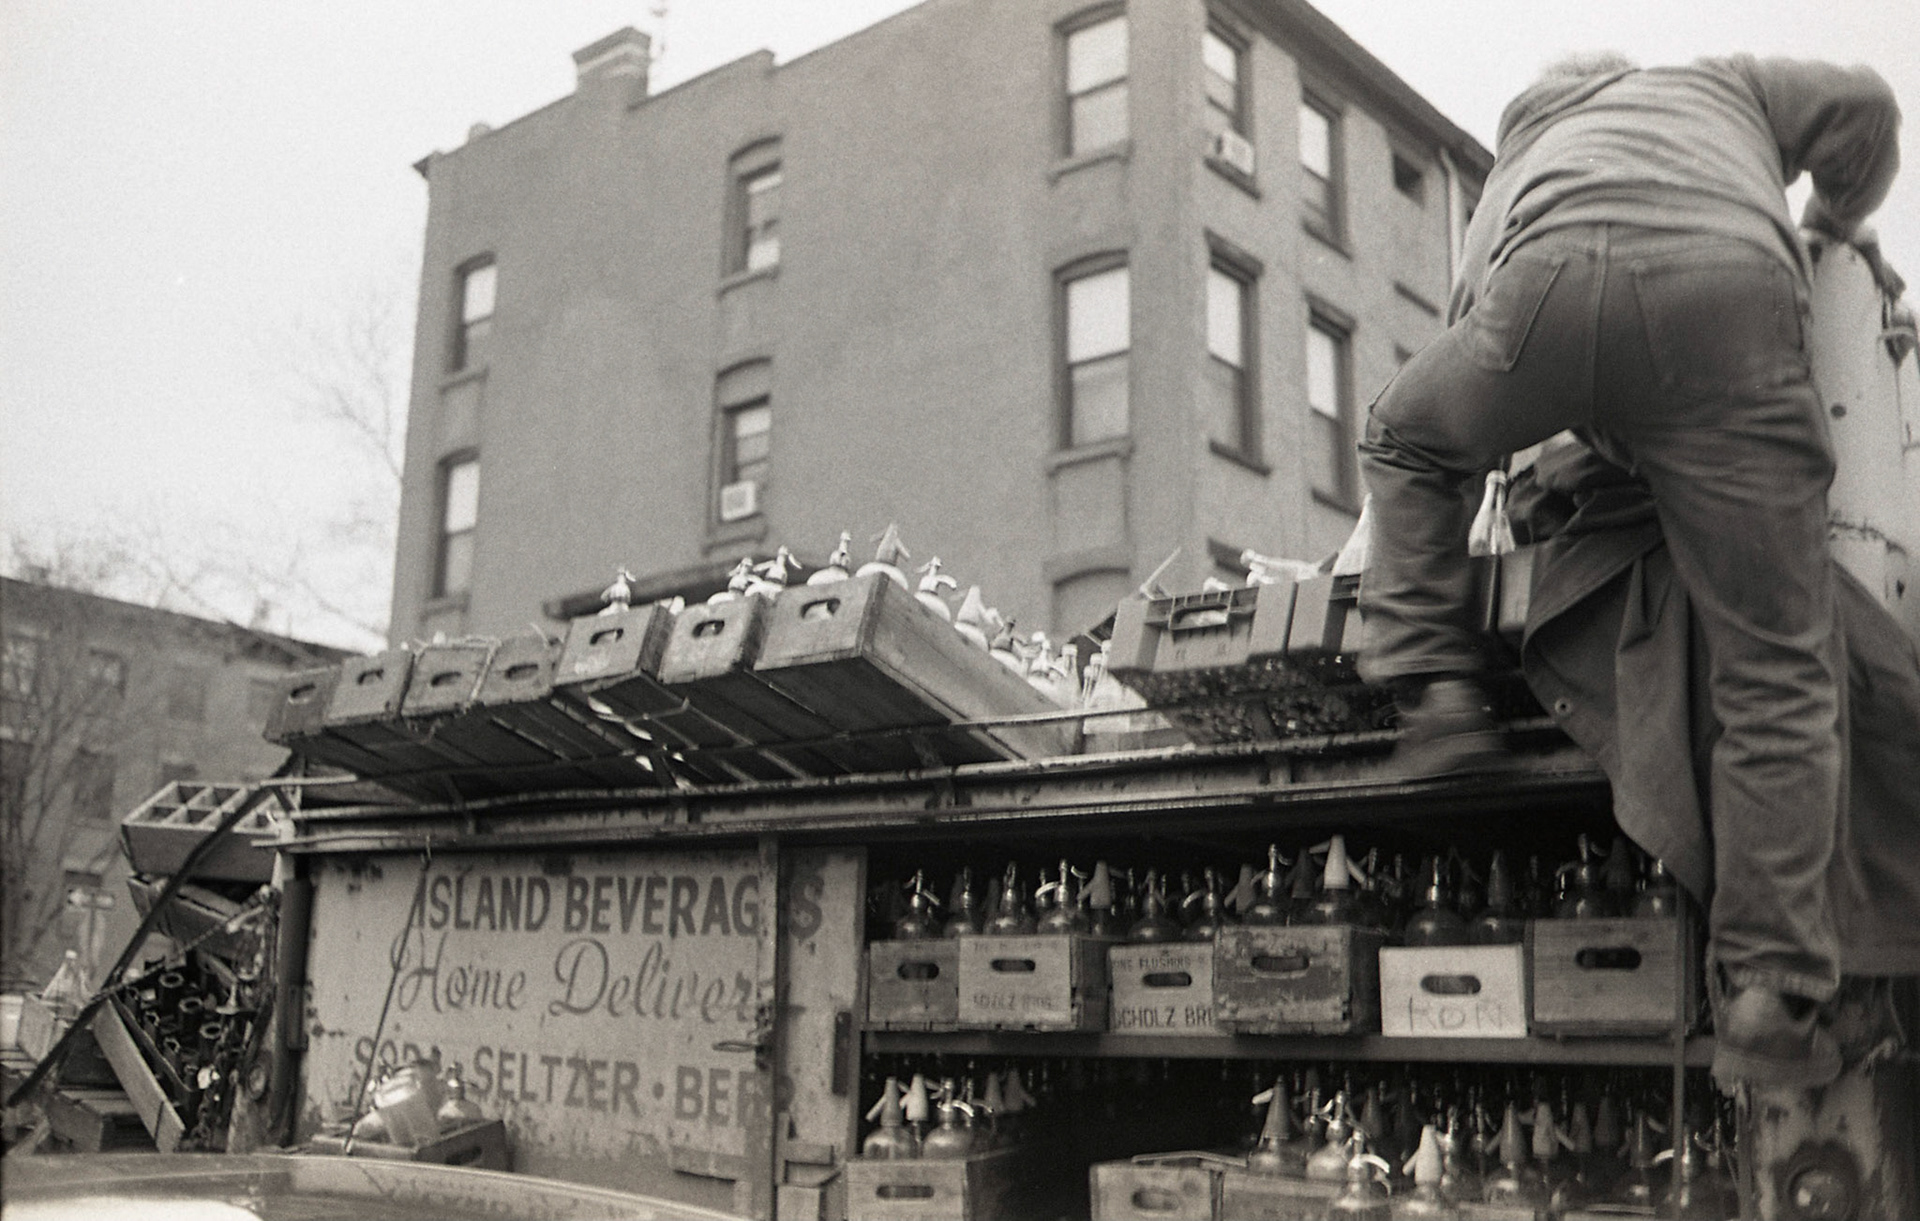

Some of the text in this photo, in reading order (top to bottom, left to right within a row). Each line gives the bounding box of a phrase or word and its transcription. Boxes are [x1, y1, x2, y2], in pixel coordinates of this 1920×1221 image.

[412, 874, 825, 940] ISLAND BEVERAGS
[390, 932, 775, 1022] Home Deliver
[466, 1045, 642, 1117] SELTZER
